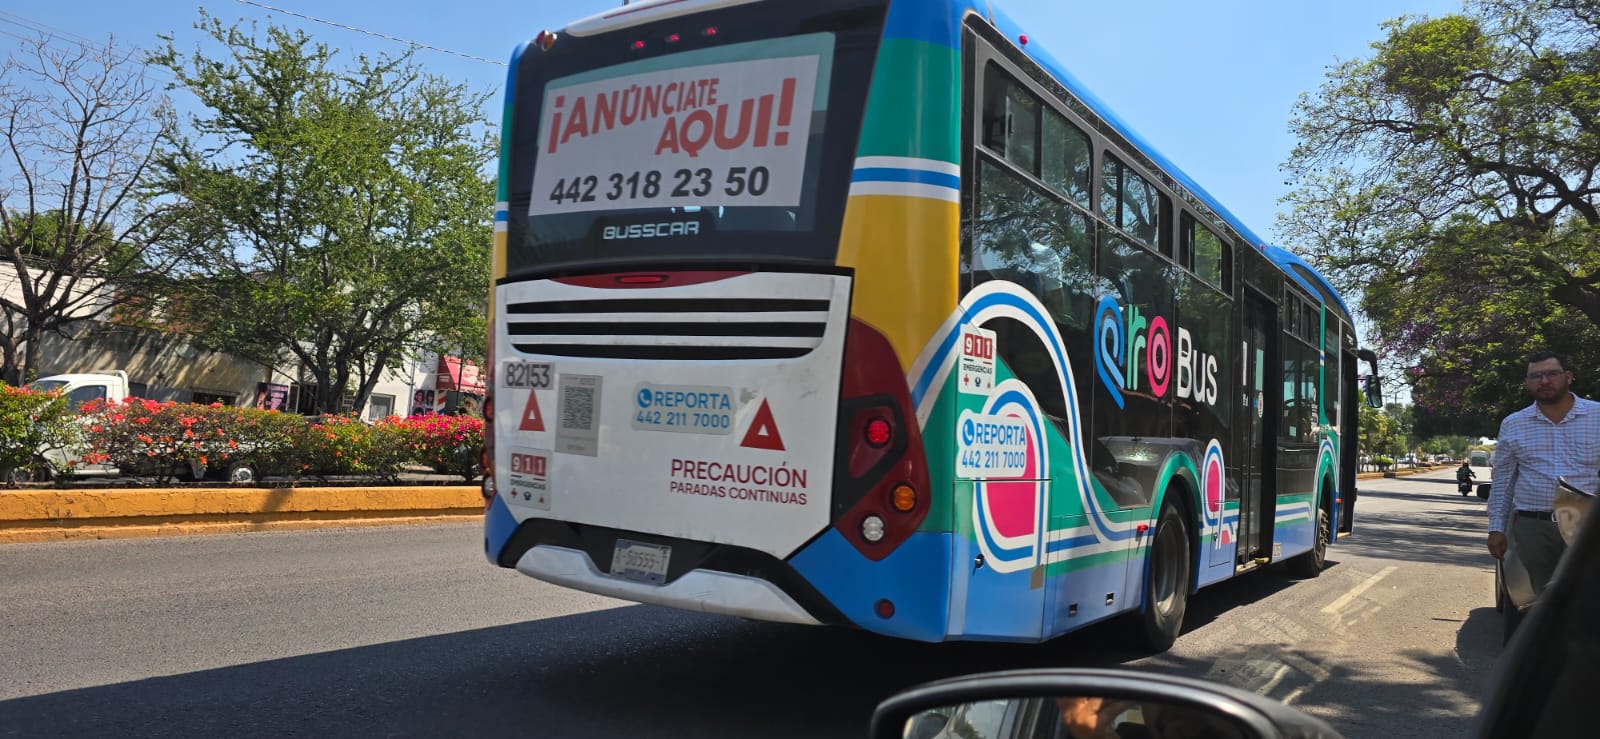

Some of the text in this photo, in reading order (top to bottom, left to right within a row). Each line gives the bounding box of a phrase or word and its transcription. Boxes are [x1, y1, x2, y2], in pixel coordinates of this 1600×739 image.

[550, 166, 770, 204] 442 318 23 50
[603, 221, 700, 240] BUSSCAR
[964, 334, 993, 359] 911
[506, 363, 550, 388] 82153
[963, 363, 993, 375] EMERGENCIAS
[1177, 326, 1218, 406] Bus
[654, 391, 731, 411] REPORTA
[636, 411, 730, 429] 442 211 7000
[975, 423, 1026, 446] REPORTA
[511, 453, 546, 476] 911
[961, 450, 1025, 469] 442 211 7000
[671, 458, 807, 489] PRECAUCIÓN
[670, 481, 807, 506] PARADAS CONTINUAS
